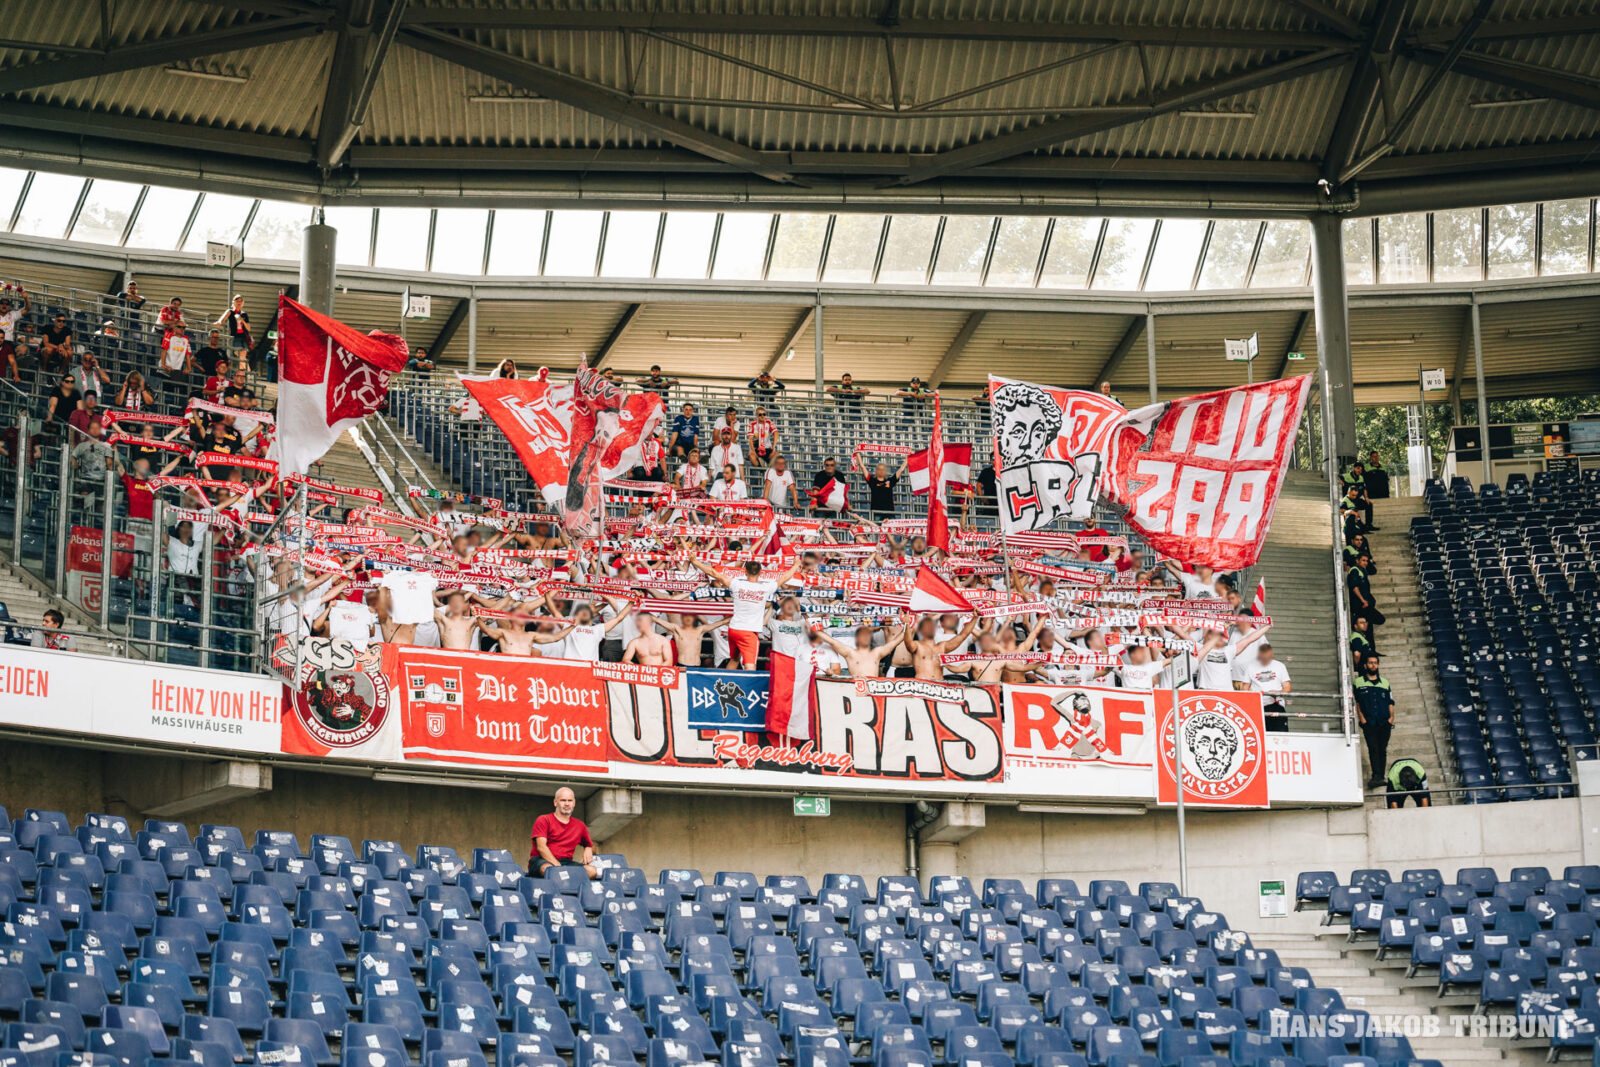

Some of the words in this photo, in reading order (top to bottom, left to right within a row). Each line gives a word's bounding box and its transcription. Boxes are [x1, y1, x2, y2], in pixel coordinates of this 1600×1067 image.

[696, 587, 725, 598] BBYC
[804, 604, 848, 614] YOUNG
[0, 664, 49, 698] EIDEN
[592, 660, 640, 672] CHRISTOPH
[640, 664, 658, 676] FÜR
[592, 668, 623, 679] IMMER
[624, 672, 638, 682] BEI
[640, 674, 658, 684] UNS
[152, 678, 205, 716] HEINZ
[210, 689, 244, 721] VON
[249, 690, 282, 725] HEI
[474, 672, 519, 703] Die
[527, 676, 601, 710] Power
[692, 686, 716, 710] BB
[868, 678, 894, 694] RED
[894, 680, 965, 701] GENERATION
[151, 714, 243, 735] MASSIVHÄUSER
[307, 716, 374, 744] REGENSBURG
[474, 714, 522, 742] vom
[528, 714, 603, 746] Tower
[606, 675, 1001, 781] ULRAS
[1165, 700, 1207, 760] CASRA
[713, 734, 855, 776] Regensburg
